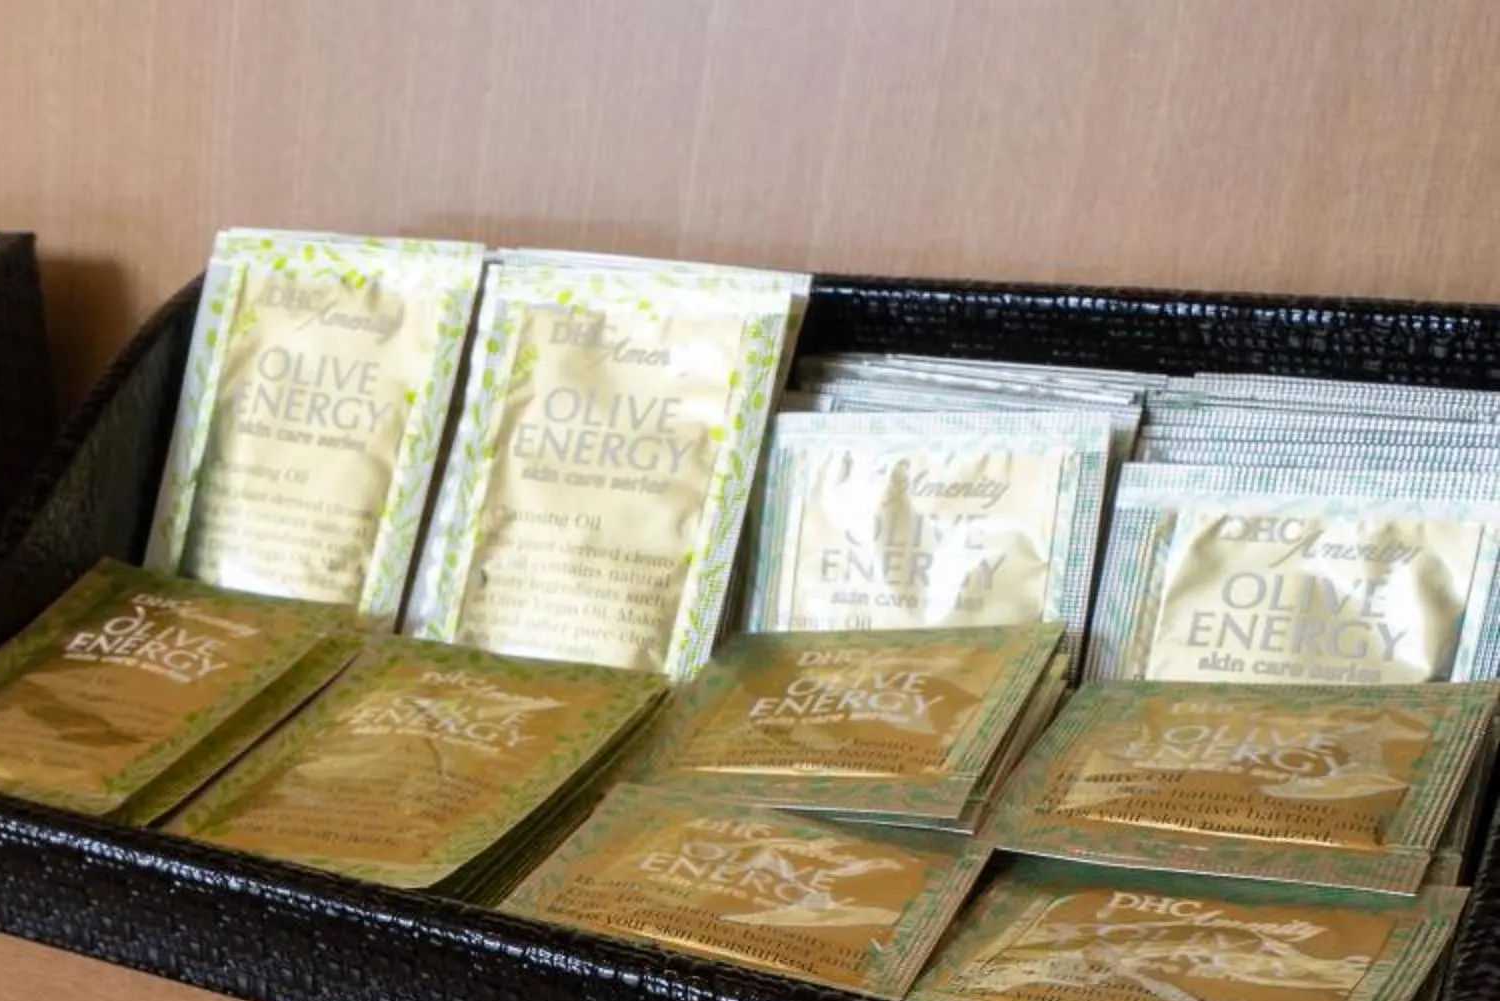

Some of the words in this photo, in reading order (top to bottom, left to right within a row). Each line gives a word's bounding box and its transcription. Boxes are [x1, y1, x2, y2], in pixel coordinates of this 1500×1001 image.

[258, 345, 381, 395] OLIVE
[234, 379, 393, 433] ENERGY
[544, 387, 682, 435] OLIVE
[514, 423, 696, 474] ENERGY
[522, 465, 560, 483] skin
[564, 471, 606, 489] care
[574, 512, 602, 531] Oil
[1220, 515, 1306, 545] DHC
[819, 548, 1006, 591] ENERY
[1221, 571, 1388, 618] OLIVE
[65, 630, 229, 677] ENERGY
[102, 613, 229, 658] OLIVE
[1186, 610, 1408, 663] ENERGY
[786, 672, 928, 697] OLIVE
[1198, 650, 1246, 673] skin
[1252, 657, 1304, 678] care
[750, 692, 943, 716] ENERGY
[1162, 724, 1342, 753] OLIVE
[1121, 741, 1359, 780] ENERGY
[640, 850, 857, 911] ENERG
[1106, 891, 1204, 918] DHC
[655, 923, 694, 941] skin
